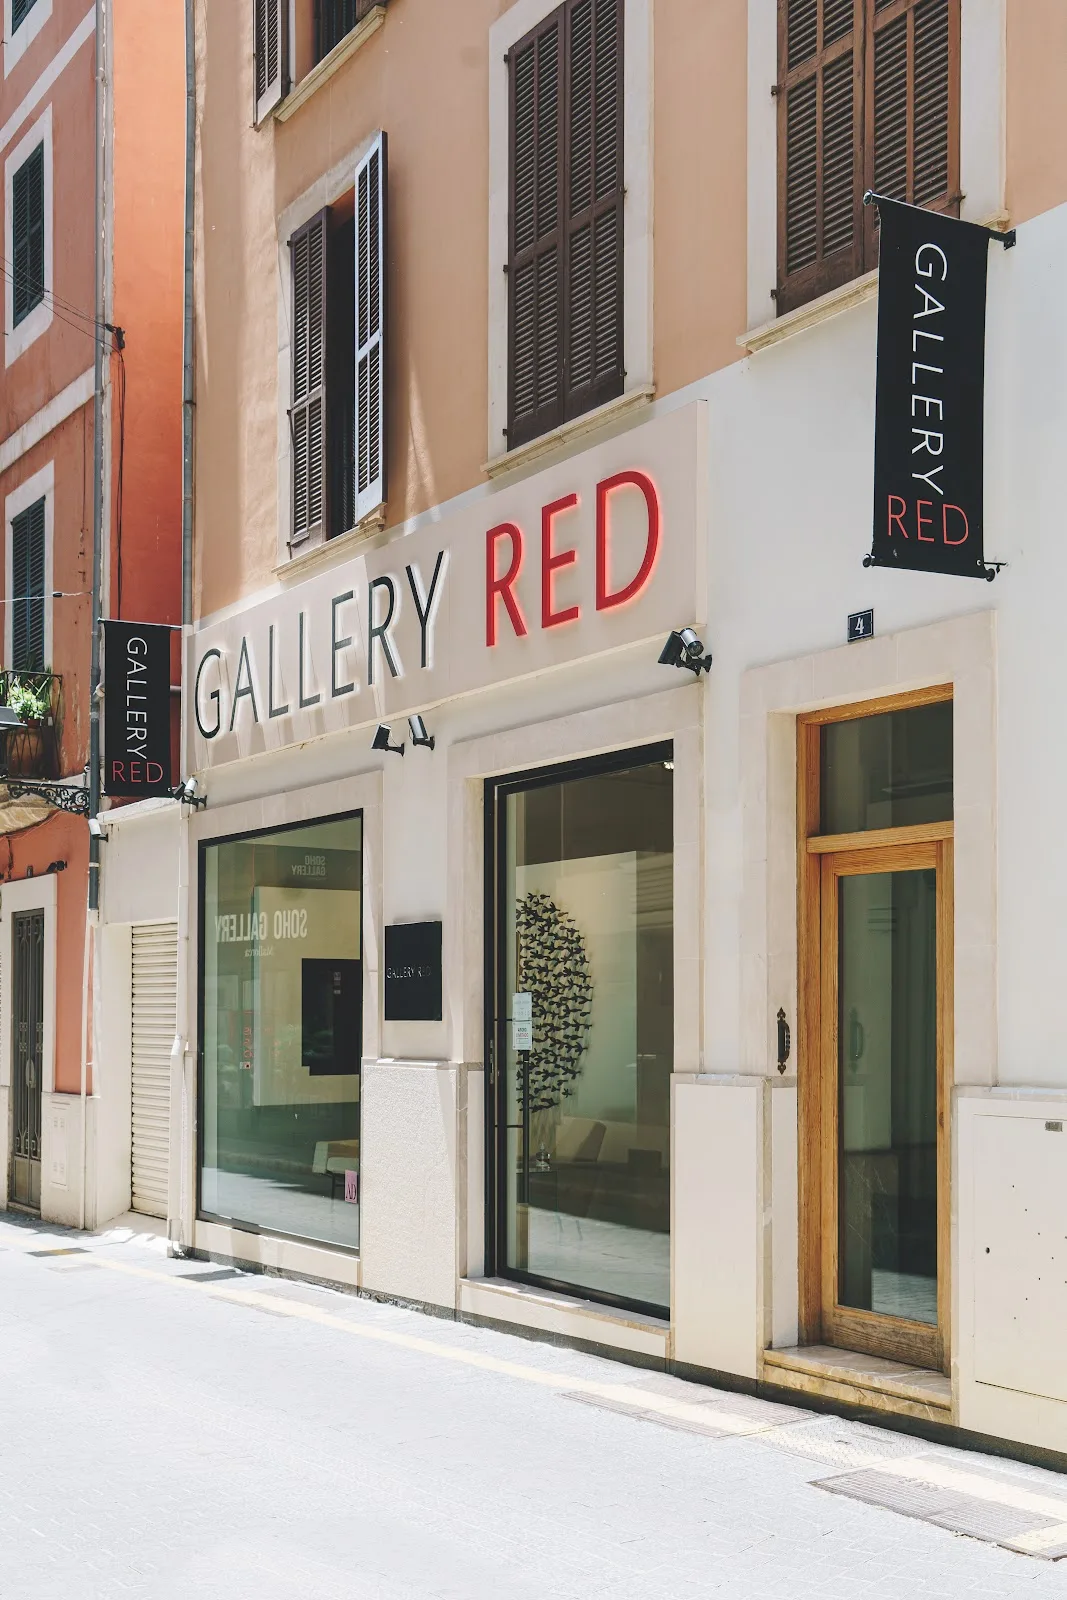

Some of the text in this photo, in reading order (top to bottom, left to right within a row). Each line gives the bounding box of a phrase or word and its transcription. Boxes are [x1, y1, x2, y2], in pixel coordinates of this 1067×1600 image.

[912, 243, 948, 495] GALLERY
[887, 495, 969, 545] RED
[194, 470, 660, 739] GALLERY RED
[855, 616, 864, 634] 4
[126, 637, 148, 760] GALLERY
[112, 760, 163, 783] RED
